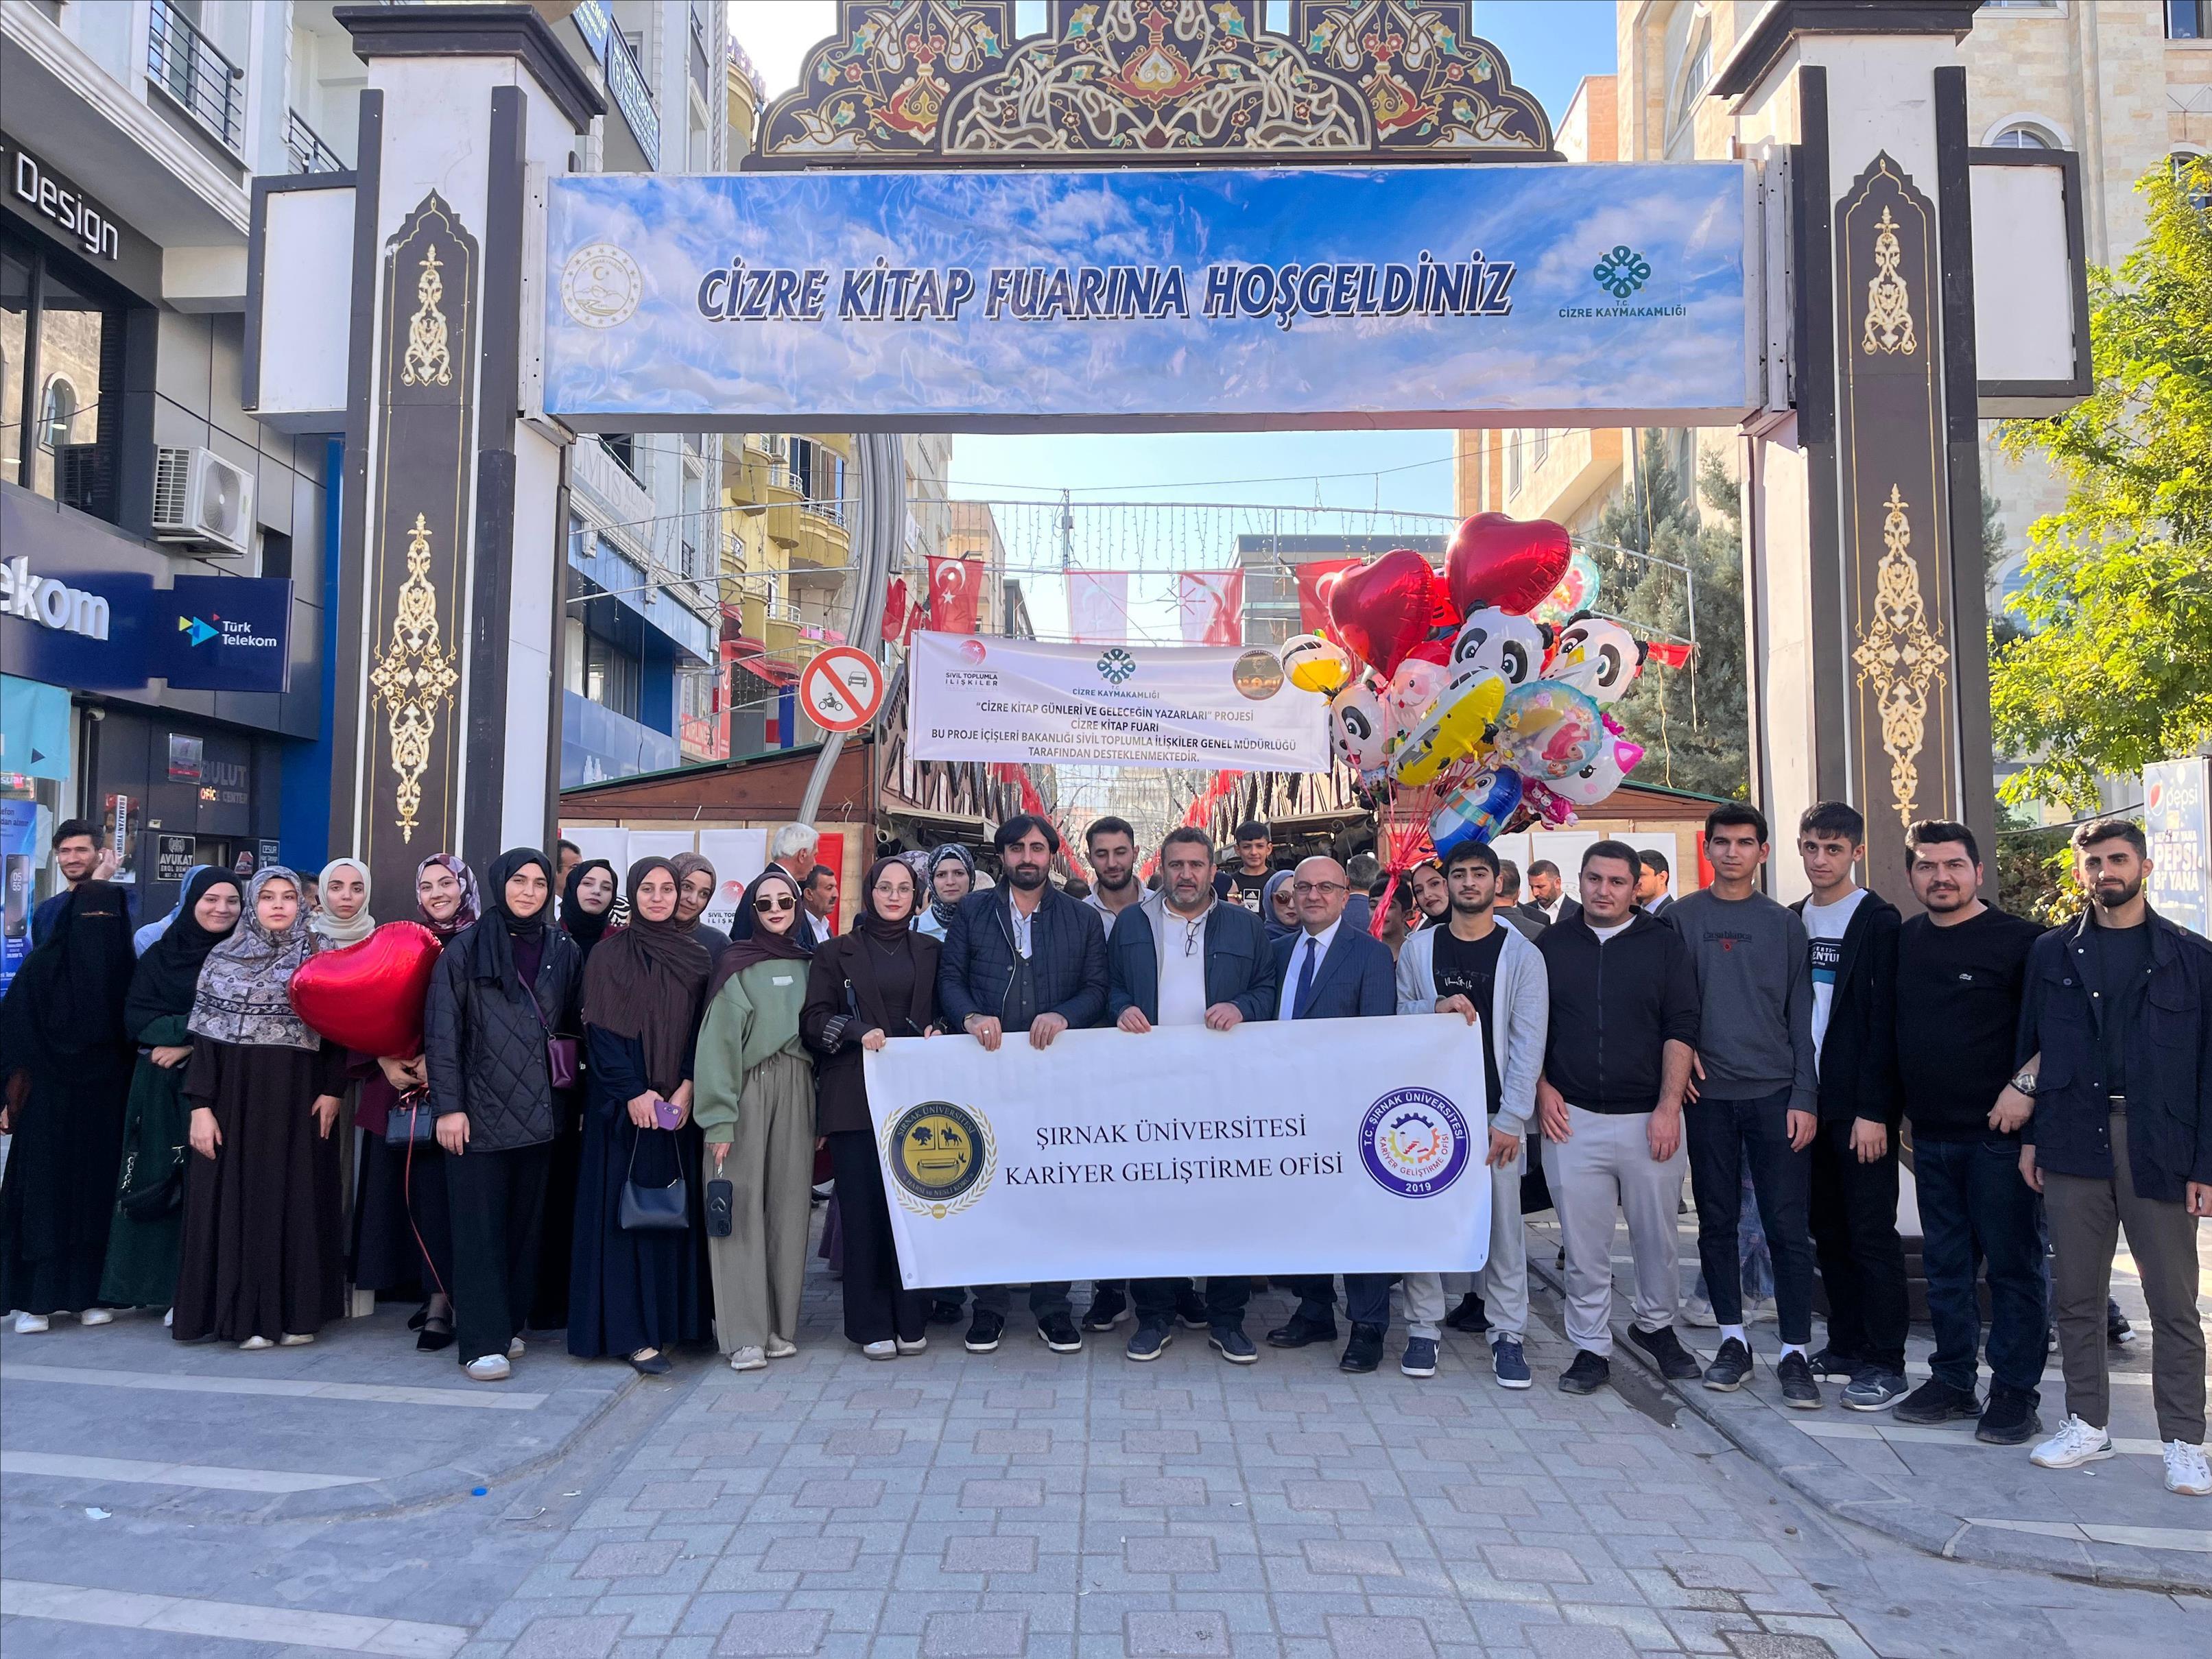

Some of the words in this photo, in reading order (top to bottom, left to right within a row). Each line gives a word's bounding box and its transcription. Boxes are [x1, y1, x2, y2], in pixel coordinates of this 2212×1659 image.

[18, 152, 119, 261] Design
[697, 256, 829, 322] CİZRE
[837, 255, 975, 322] KİTAP
[983, 264, 1190, 322] FUARINA
[1202, 248, 1517, 331] HOŞGELDİNİZ
[1558, 306, 1593, 318] CİZRE
[1595, 304, 1687, 318] KAYMAKAMLIĞI
[222, 621, 251, 633] Türk
[222, 634, 277, 647] Telekom
[1072, 688, 1096, 696] CİZRE
[1097, 689, 1160, 699] KAYMAKAMLIĞI
[1011, 701, 1038, 713] KİTAP
[1041, 702, 1083, 715] GÜNLERİ
[1085, 706, 1097, 715] VE
[1099, 706, 1152, 718] GELECEĞİN
[1215, 710, 1254, 721] PROJESİ
[1071, 717, 1098, 730] CİZRE
[1101, 718, 1128, 731] KİTAP
[1131, 722, 1158, 732] FUARI
[931, 728, 944, 739] BU
[947, 729, 979, 740] PROJE
[981, 728, 1019, 743] İÇİŞLERİ
[1022, 731, 1074, 743] BAKANLIĞI
[1076, 731, 1099, 744] SİVİL
[1101, 735, 1153, 746] TOPLUMLA
[1155, 734, 1198, 749] İLİŞKİLER
[1200, 739, 1233, 749] GENEL
[1234, 737, 1296, 751] MÜDÜRLÜĞÜ
[1028, 746, 1091, 759] TARAFINDAN
[1093, 748, 1200, 763] DESTEKLENMEKTEDİR.
[2166, 782, 2198, 812] pepsi
[160, 853, 193, 865] AVUKAT
[2169, 871, 2200, 892] YANA
[897, 1110, 923, 1137] ŞIRNAK
[923, 1105, 977, 1135] ÜNİVERSİTESİ
[1368, 1094, 1403, 1125] ŞIRNAK
[1405, 1092, 1466, 1140] ÜNİVERSİTESİ
[1036, 1123, 1129, 1151] ŞIRNAK
[1136, 1113, 1307, 1143] ÜNİVERSİTESİ
[1379, 1136, 1399, 1169] KARİYER
[1400, 1156, 1444, 1178] GELİŞTİRME
[1441, 1133, 1450, 1155] OFİSİ
[1005, 1161, 1115, 1186] KARİYER
[1122, 1156, 1274, 1185] GELİŞTİRME
[1279, 1151, 1344, 1177] OFİSİ
[1405, 1181, 1432, 1193] 2019
